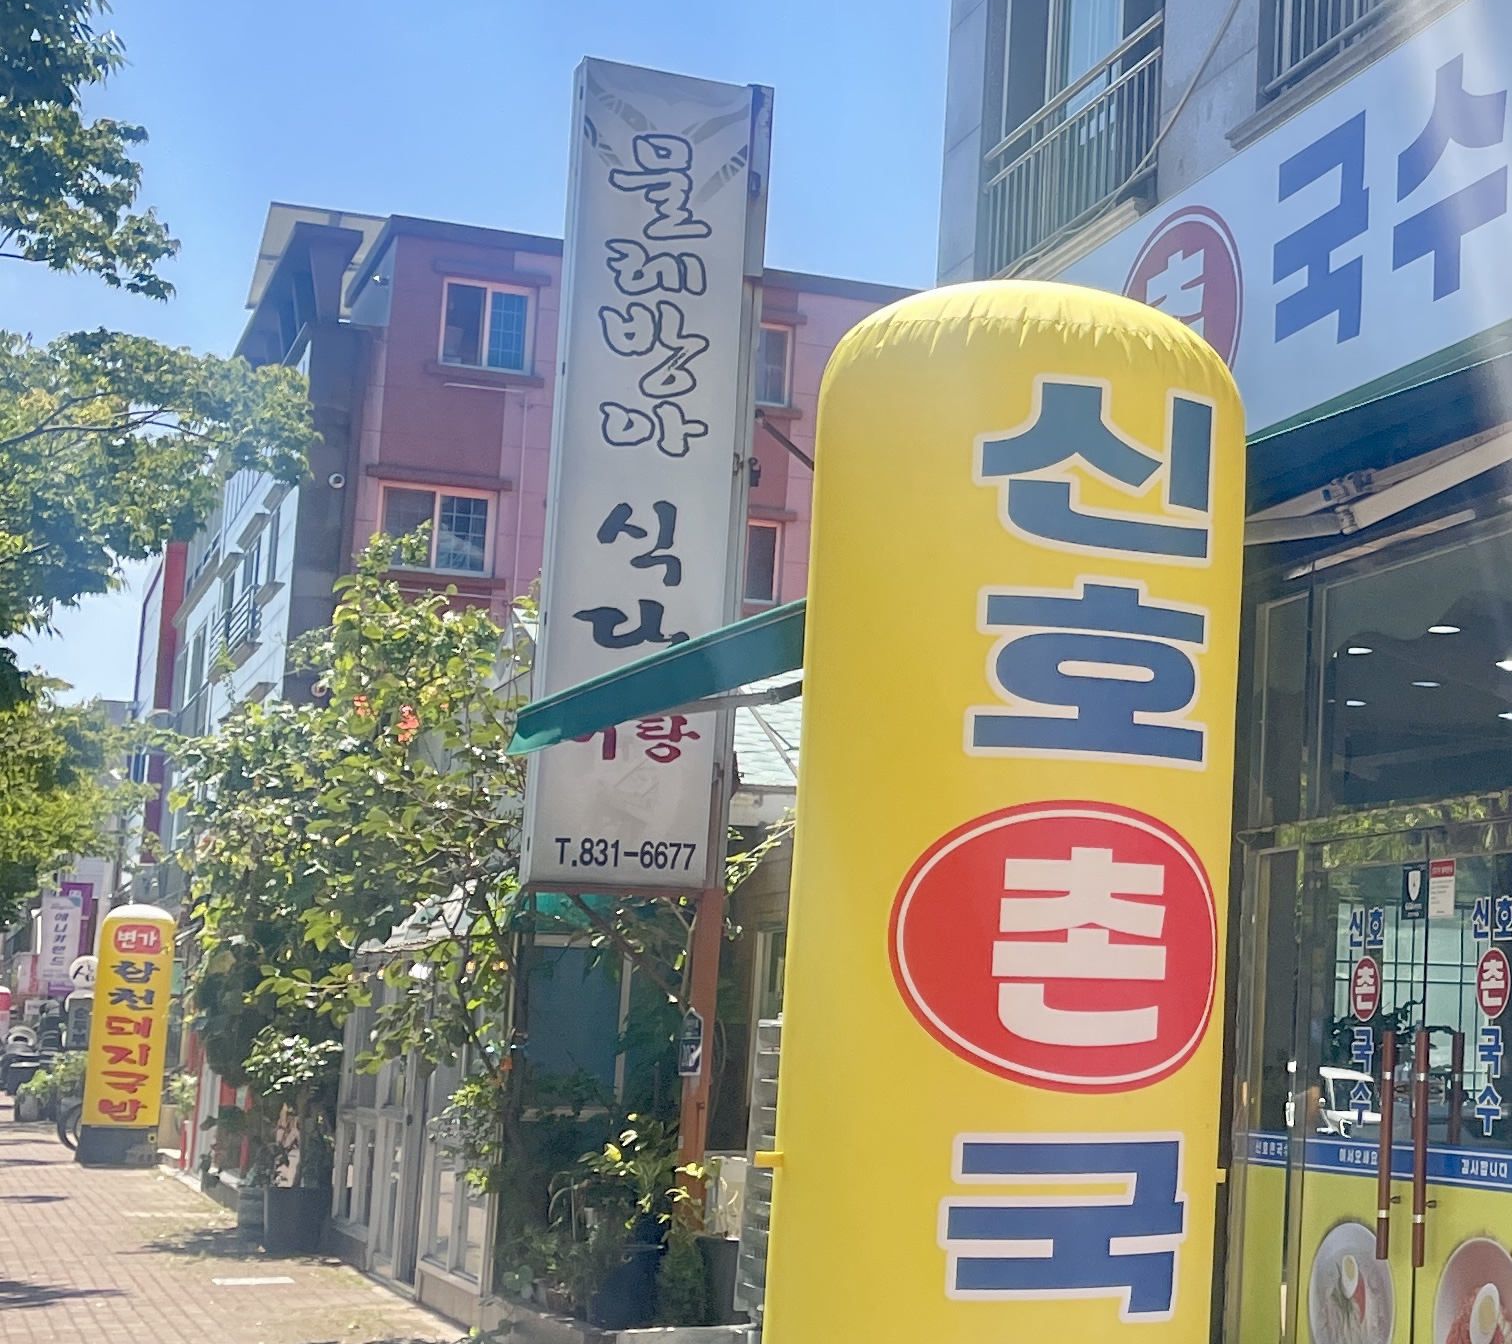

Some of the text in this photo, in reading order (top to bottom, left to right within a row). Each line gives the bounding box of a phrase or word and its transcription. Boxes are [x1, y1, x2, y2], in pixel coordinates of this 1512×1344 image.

[598, 133, 713, 458] 물레방아
[117, 929, 158, 950] 변가
[1461, 1158, 1508, 1179] 감사합니다
